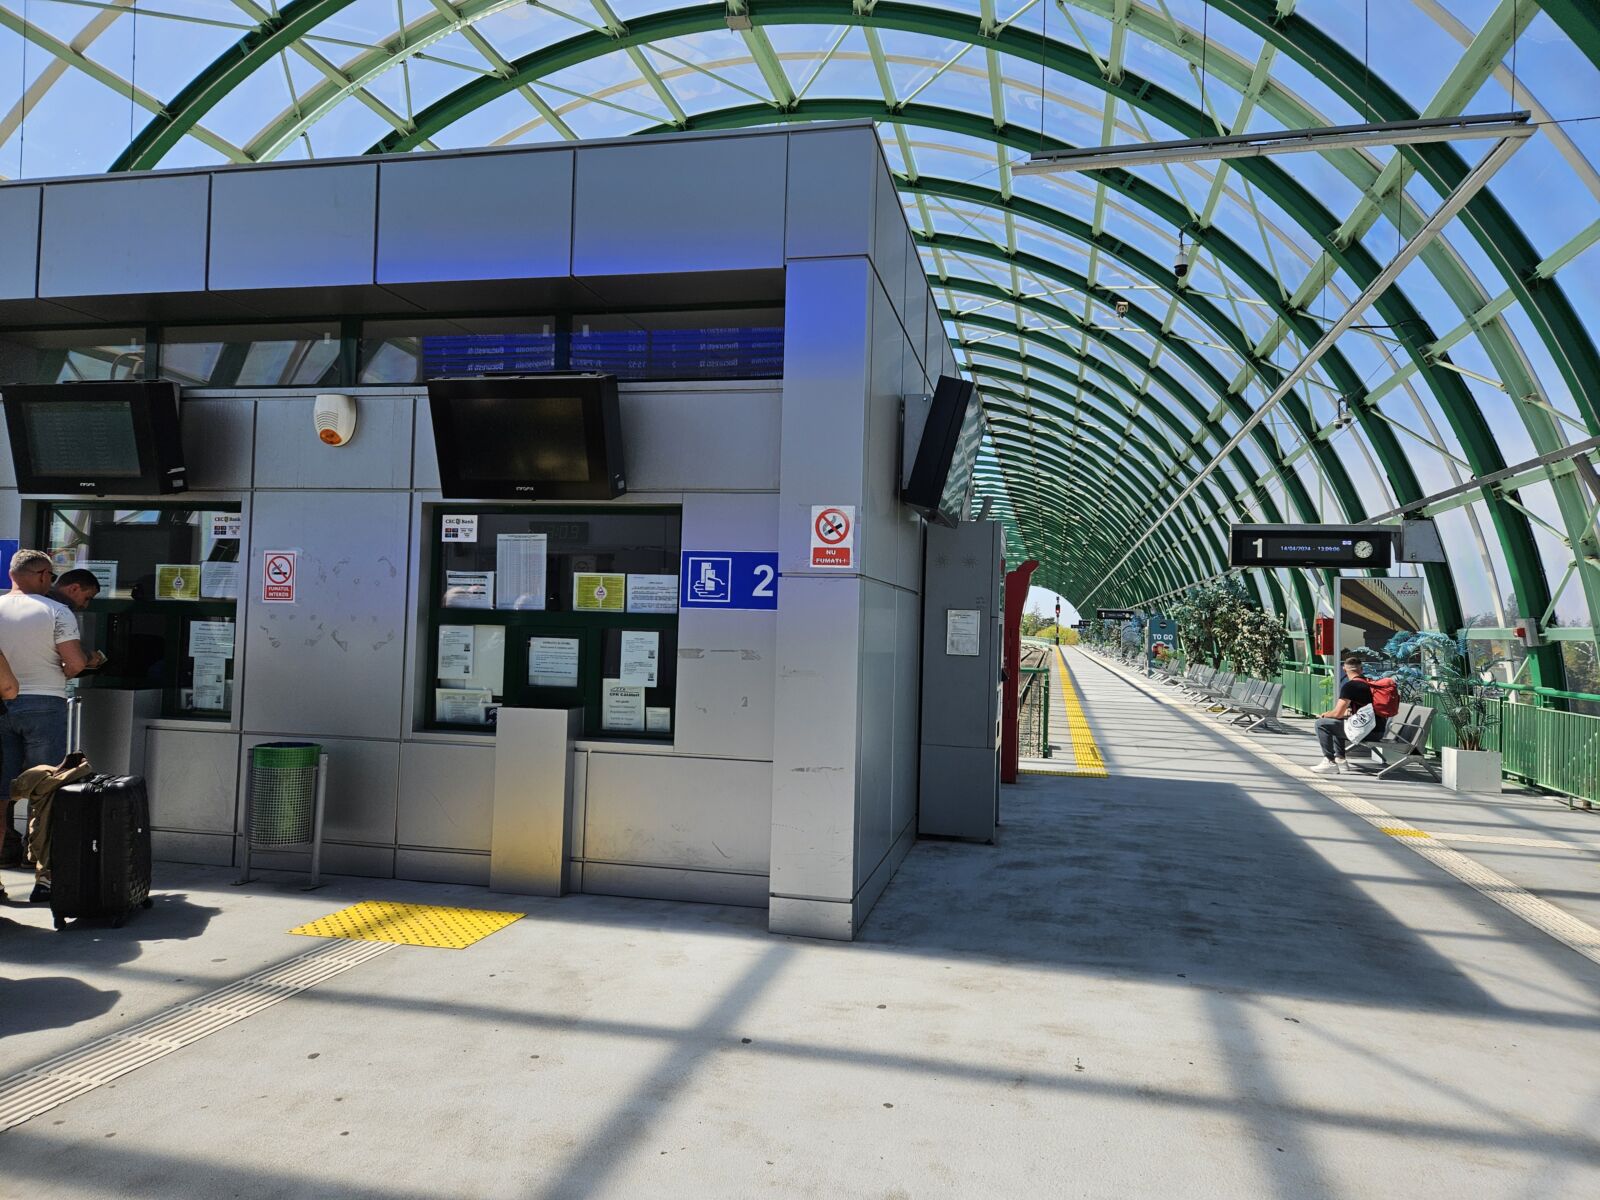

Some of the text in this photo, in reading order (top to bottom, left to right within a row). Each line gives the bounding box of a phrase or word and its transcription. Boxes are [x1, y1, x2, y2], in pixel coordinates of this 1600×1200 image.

[1252, 538, 1264, 559] 1
[752, 564, 775, 598] 2
[1152, 633, 1174, 641] TO GO
